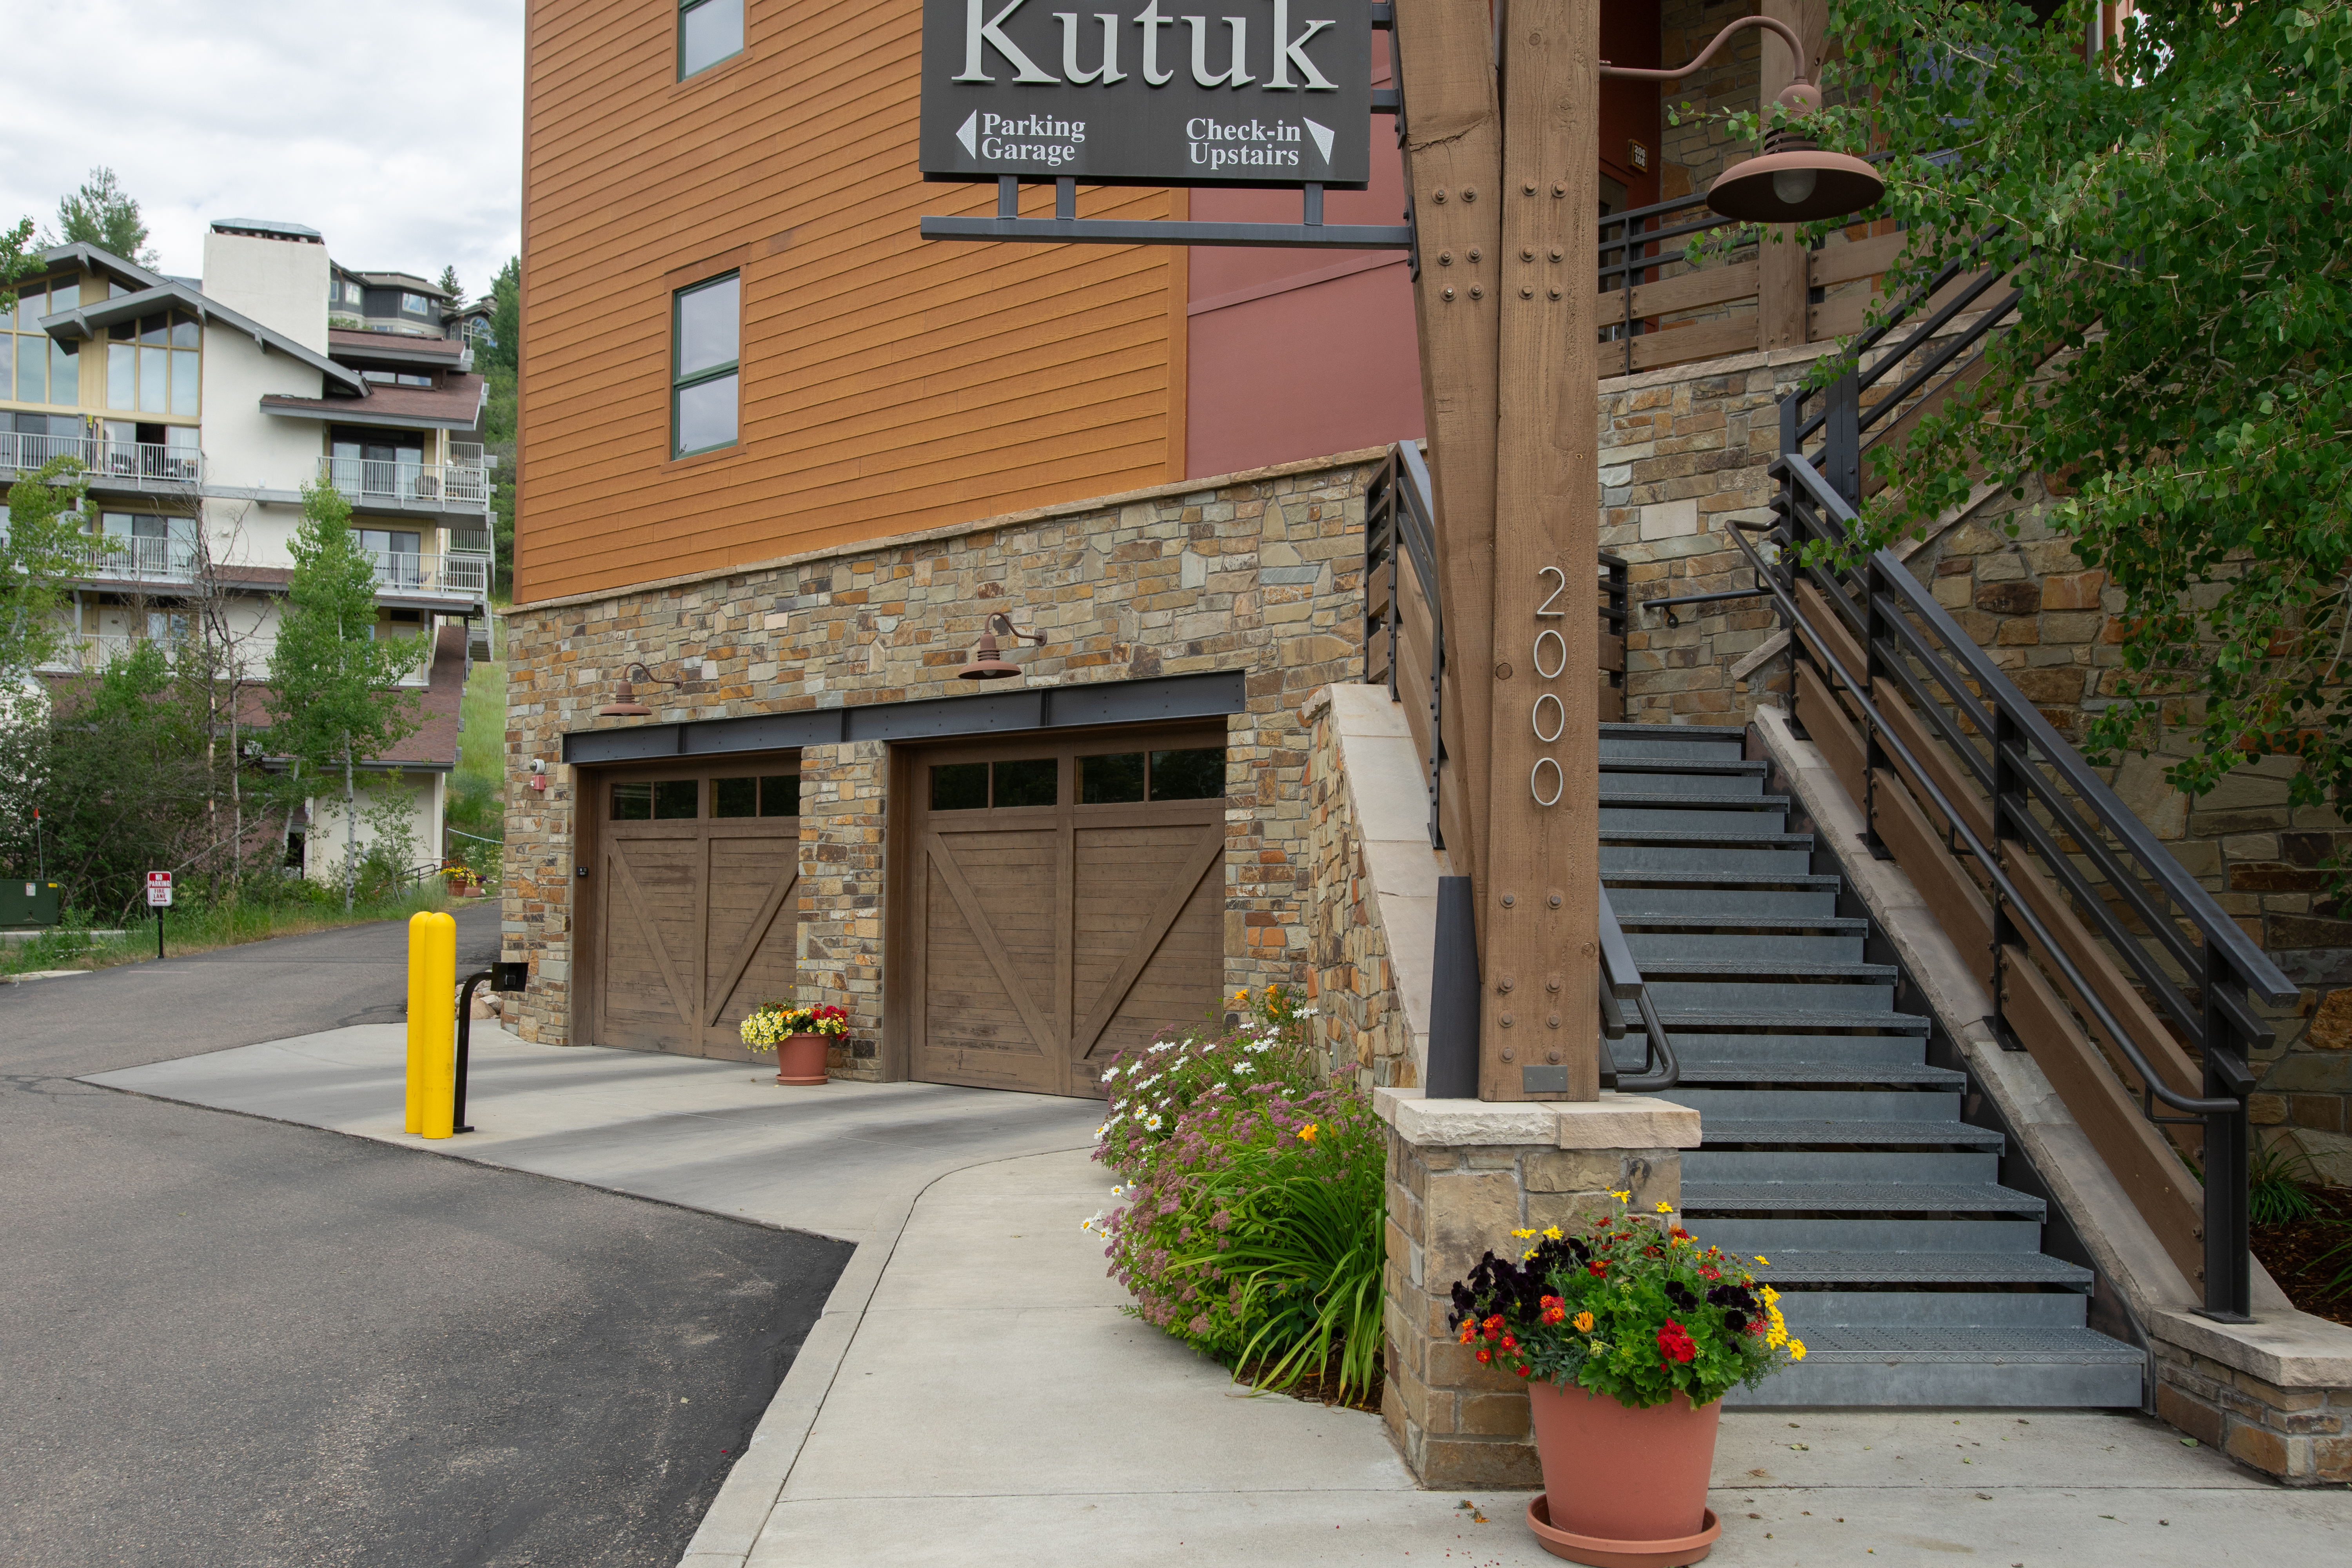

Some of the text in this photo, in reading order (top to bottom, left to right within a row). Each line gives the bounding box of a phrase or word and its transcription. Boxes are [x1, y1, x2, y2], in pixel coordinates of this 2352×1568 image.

[951, 0, 1339, 89] Kutuk
[982, 113, 1085, 143] Parking
[1186, 118, 1301, 141] Check-in
[982, 137, 1075, 166] Garage
[1189, 142, 1299, 170] Upstairs
[1635, 145, 1646, 158] 206
[1635, 154, 1645, 167] 106
[1531, 566, 1566, 806] 2000
